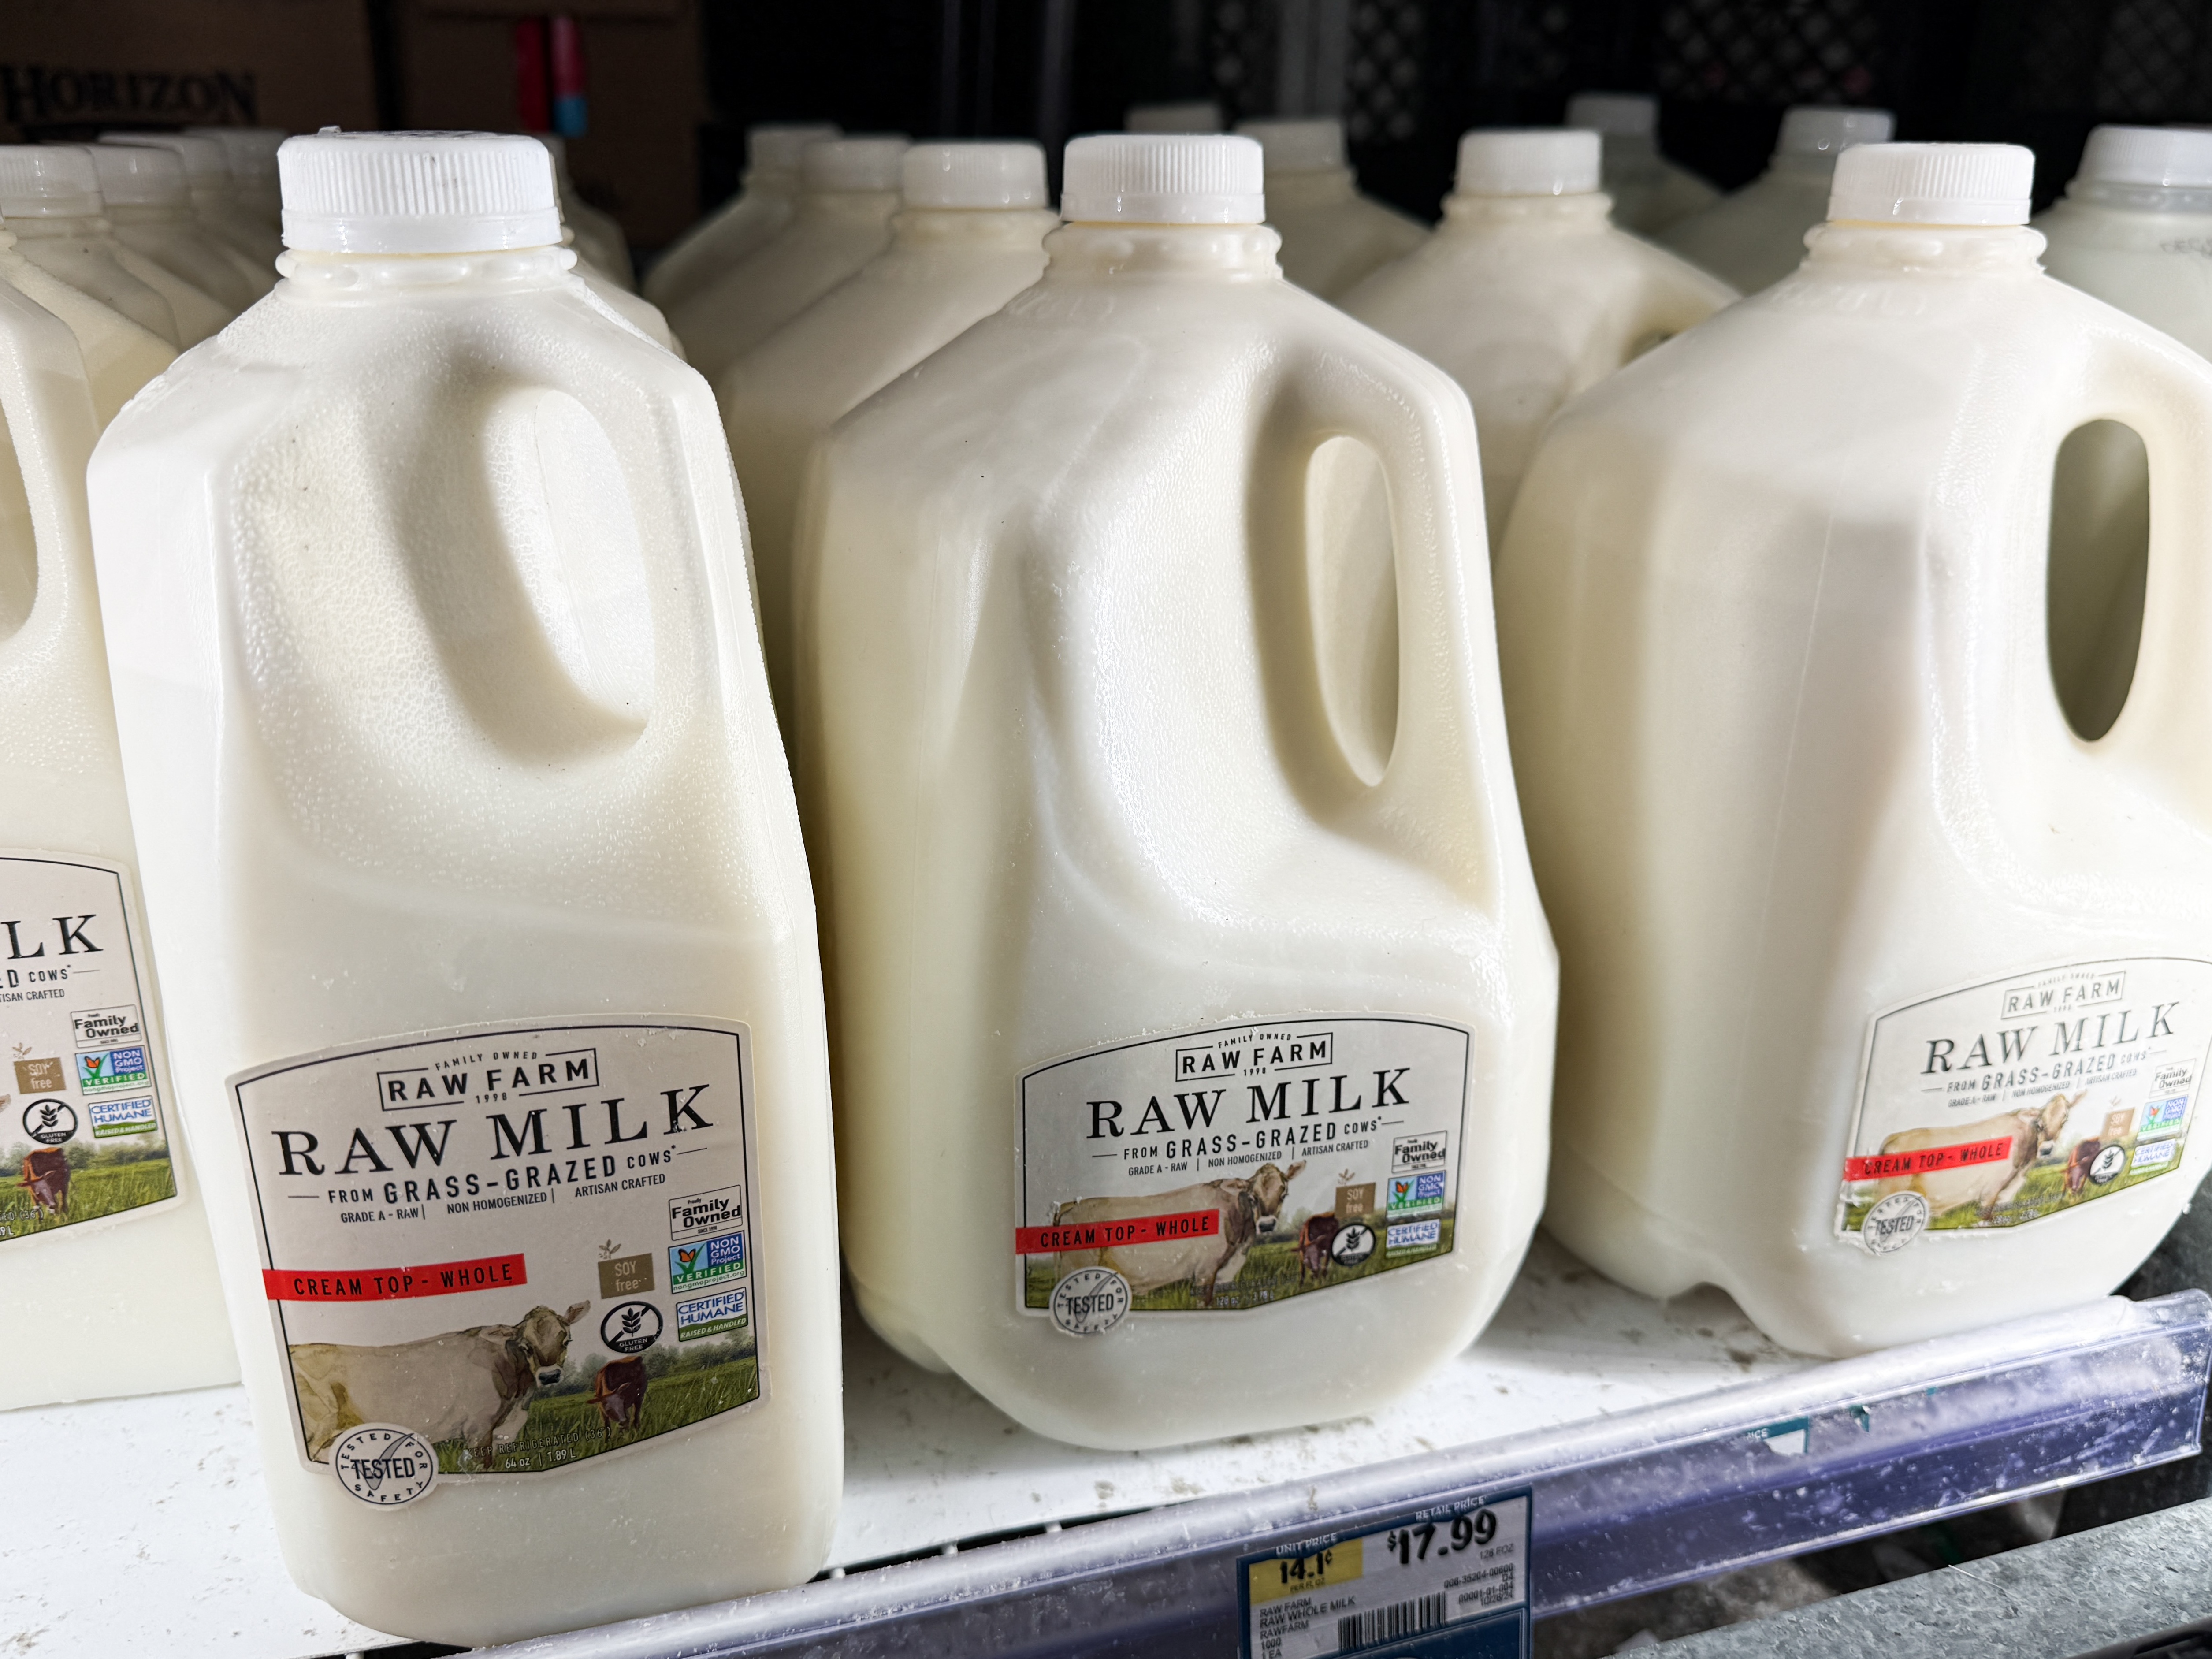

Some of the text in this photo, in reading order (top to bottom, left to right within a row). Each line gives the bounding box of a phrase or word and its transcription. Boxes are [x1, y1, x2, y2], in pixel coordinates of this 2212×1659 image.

[1, 66, 256, 124] HORIZON
[26, 989, 65, 1000] CRAFTED
[2008, 979, 2120, 1012] RAW FARM
[74, 1015, 126, 1029] Family
[86, 1023, 139, 1038] Owned
[1920, 1001, 2179, 1075] RAW MILK
[1218, 1034, 1253, 1049] FAMILY
[113, 1049, 141, 1060] NON
[115, 1057, 142, 1067] GMO
[435, 1051, 537, 1071] FAMILY OWNED
[1182, 1041, 1326, 1074] RAW FARM
[28, 1063, 49, 1075] SOY
[115, 1065, 144, 1074] Project
[1243, 1067, 1266, 1076] 1998
[2085, 1068, 2137, 1086] ARTISAN CRAFTED
[2155, 1068, 2188, 1081] Family
[31, 1077, 52, 1090] free
[85, 1072, 145, 1086] VERIFIED
[388, 1059, 589, 1101] RAW FARM
[1947, 1079, 1975, 1093] FROM
[2159, 1074, 2192, 1090] Owned
[476, 1092, 508, 1103] 1998
[1948, 1096, 1969, 1107] GRADE
[1983, 1093, 1996, 1102] RAW
[2011, 1088, 2025, 1098] NON
[91, 1099, 152, 1114] CERTIFIED
[1086, 1067, 1411, 1139] RAW MILK
[94, 1108, 152, 1123] HUMANE
[125, 1123, 156, 1132] HANDLED
[271, 1084, 714, 1175] RAW MILK
[1124, 1146, 1158, 1160] FROM
[1166, 1122, 1336, 1159] GRASS-GRAZED
[1301, 1140, 1368, 1157] ARTISAN CRAFTED
[1394, 1140, 1438, 1155] Family
[2135, 1141, 2174, 1156] CERTIFIED
[1208, 1150, 1282, 1168] NON HOMOGENIZED
[1402, 1147, 1446, 1163] Owned
[1864, 1142, 2004, 1175] CREAM TOP WHOLE
[1128, 1161, 1188, 1176] GRADE A RAW
[328, 1188, 374, 1203] FROM
[383, 1155, 616, 1204] GRASS-GRAZED
[575, 1173, 665, 1198] ARTISAN CRAFTED
[1419, 1175, 1441, 1184] NON
[1347, 1187, 1364, 1200] SOY
[447, 1192, 547, 1214] NON HOMOGENIZED
[672, 1198, 729, 1219] Family
[1346, 1202, 1364, 1213] free
[341, 1208, 419, 1223] GRADE A RAW
[684, 1205, 741, 1228] Owned
[1041, 1216, 1209, 1247] CREAM TOP WHOLE
[1388, 1222, 1438, 1235] CERTIFIED
[1876, 1215, 1914, 1235] TESTED
[710, 1236, 739, 1250] NON
[1388, 1230, 1436, 1244] HUMANE
[710, 1245, 740, 1258] GMO
[711, 1254, 741, 1265] Project
[614, 1261, 636, 1276] SOY
[677, 1262, 741, 1283] VERIFIED
[294, 1263, 512, 1295] CREAM TOP WHOLE
[615, 1278, 639, 1292] free
[673, 1270, 745, 1291] nongmoproject.org
[1057, 1273, 1100, 1308] TESTED
[678, 1291, 744, 1314] CERTIFIED
[1066, 1293, 1114, 1315] TESTED
[680, 1302, 744, 1325] HUMANE
[680, 1328, 706, 1339] RAISED
[713, 1318, 746, 1331] HANDLED
[619, 1338, 647, 1347] GLUTEN
[341, 1433, 428, 1469] TESTED FOR
[466, 1446, 492, 1457] KEEP
[498, 1432, 579, 1454] REFRIGERATED
[506, 1458, 517, 1469] 64
[547, 1449, 567, 1462] 1.89
[570, 1448, 576, 1458] L
[350, 1457, 416, 1479] TESTED
[355, 1481, 424, 1502] SAFETY
[1416, 1495, 1484, 1521] RETAIL PRICE
[1276, 1532, 1338, 1555] UNIT PRICE
[1387, 1508, 1497, 1564] $17.99
[1480, 1548, 1494, 1559] 128
[1502, 1571, 1513, 1582] D4
[1290, 1584, 1305, 1592] PER
[1260, 1597, 1312, 1617] RAW FARM
[1260, 1595, 1355, 1629] RAW WHOLE MILK
[1260, 1619, 1309, 1640] RAWFARM
[1268, 1648, 1282, 1659] EA
